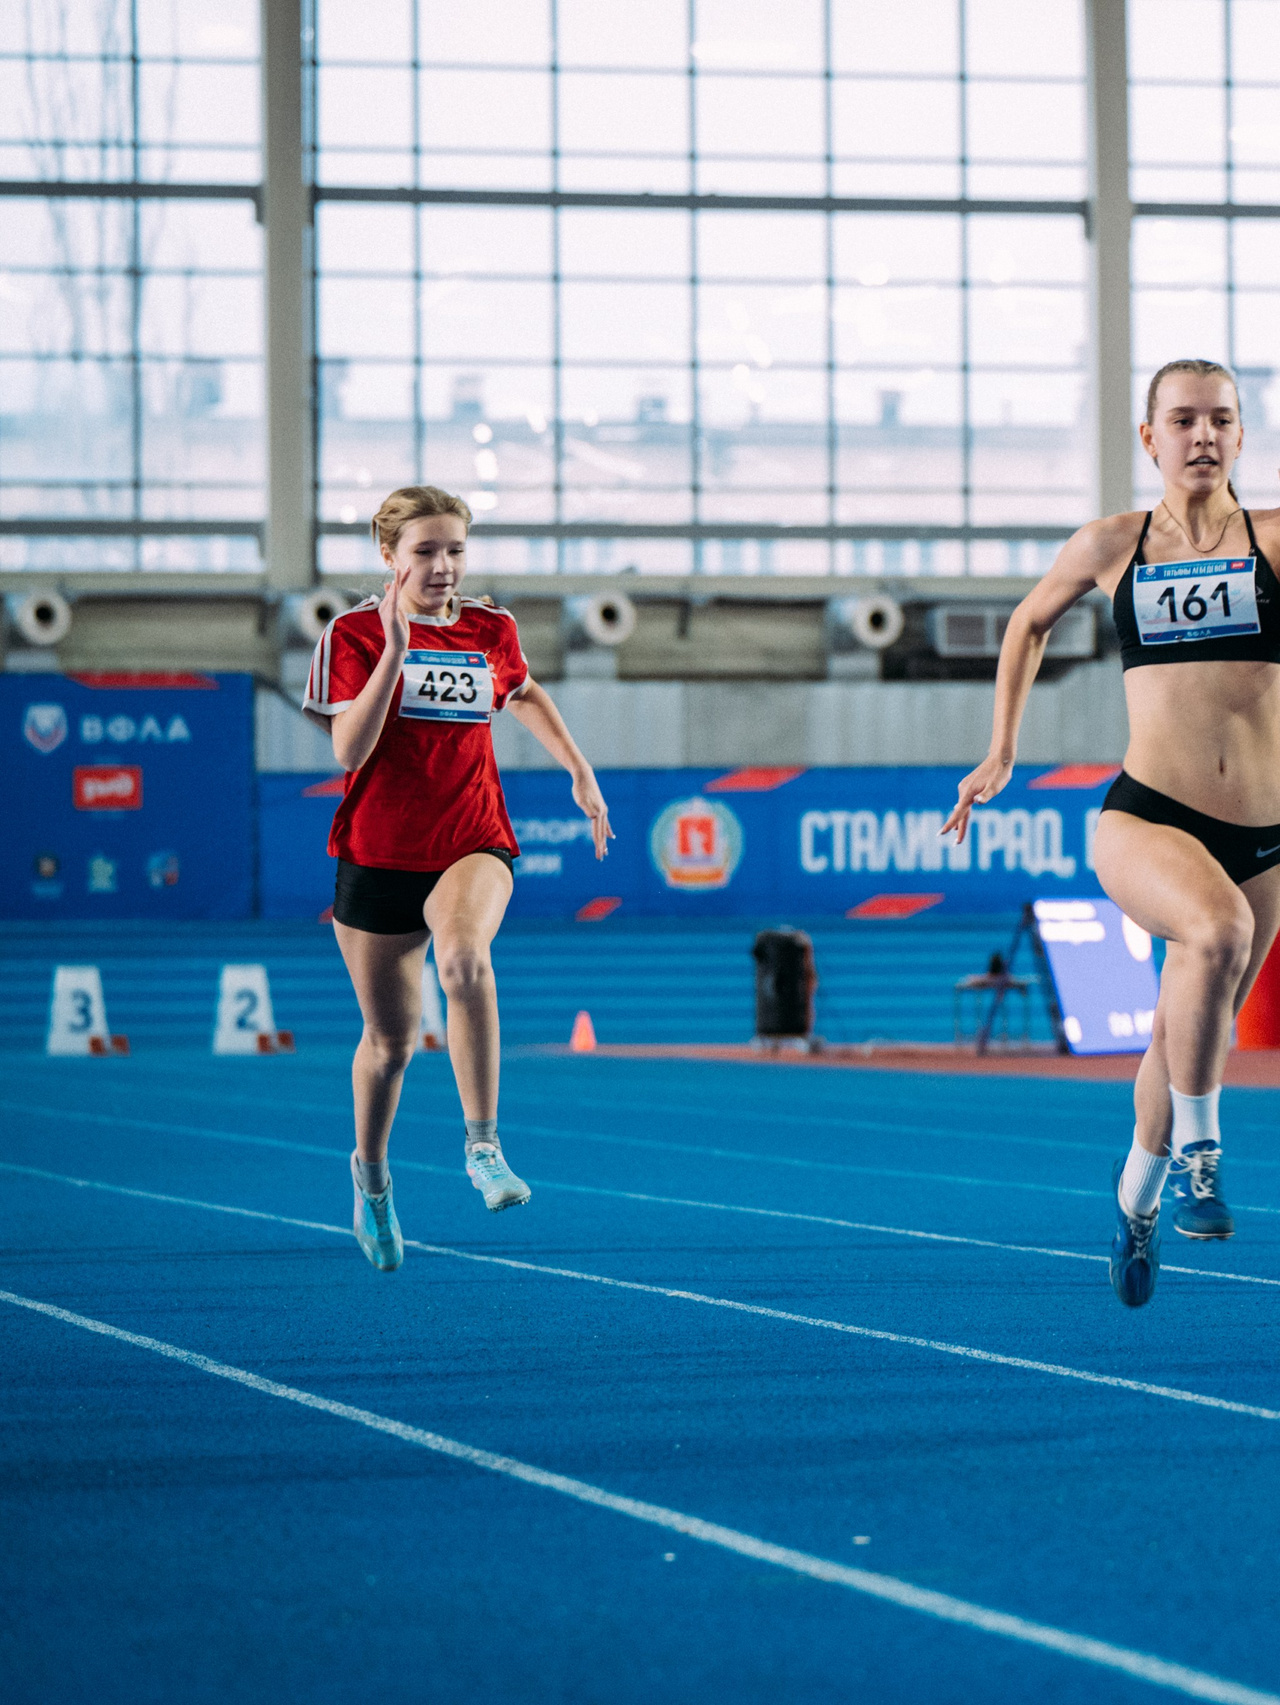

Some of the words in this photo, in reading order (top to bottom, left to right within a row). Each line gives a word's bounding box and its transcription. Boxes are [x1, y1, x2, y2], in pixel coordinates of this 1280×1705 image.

[1157, 581, 1232, 623] 161
[418, 671, 478, 704] 423
[68, 989, 93, 1033] 3
[234, 988, 258, 1031] 2
